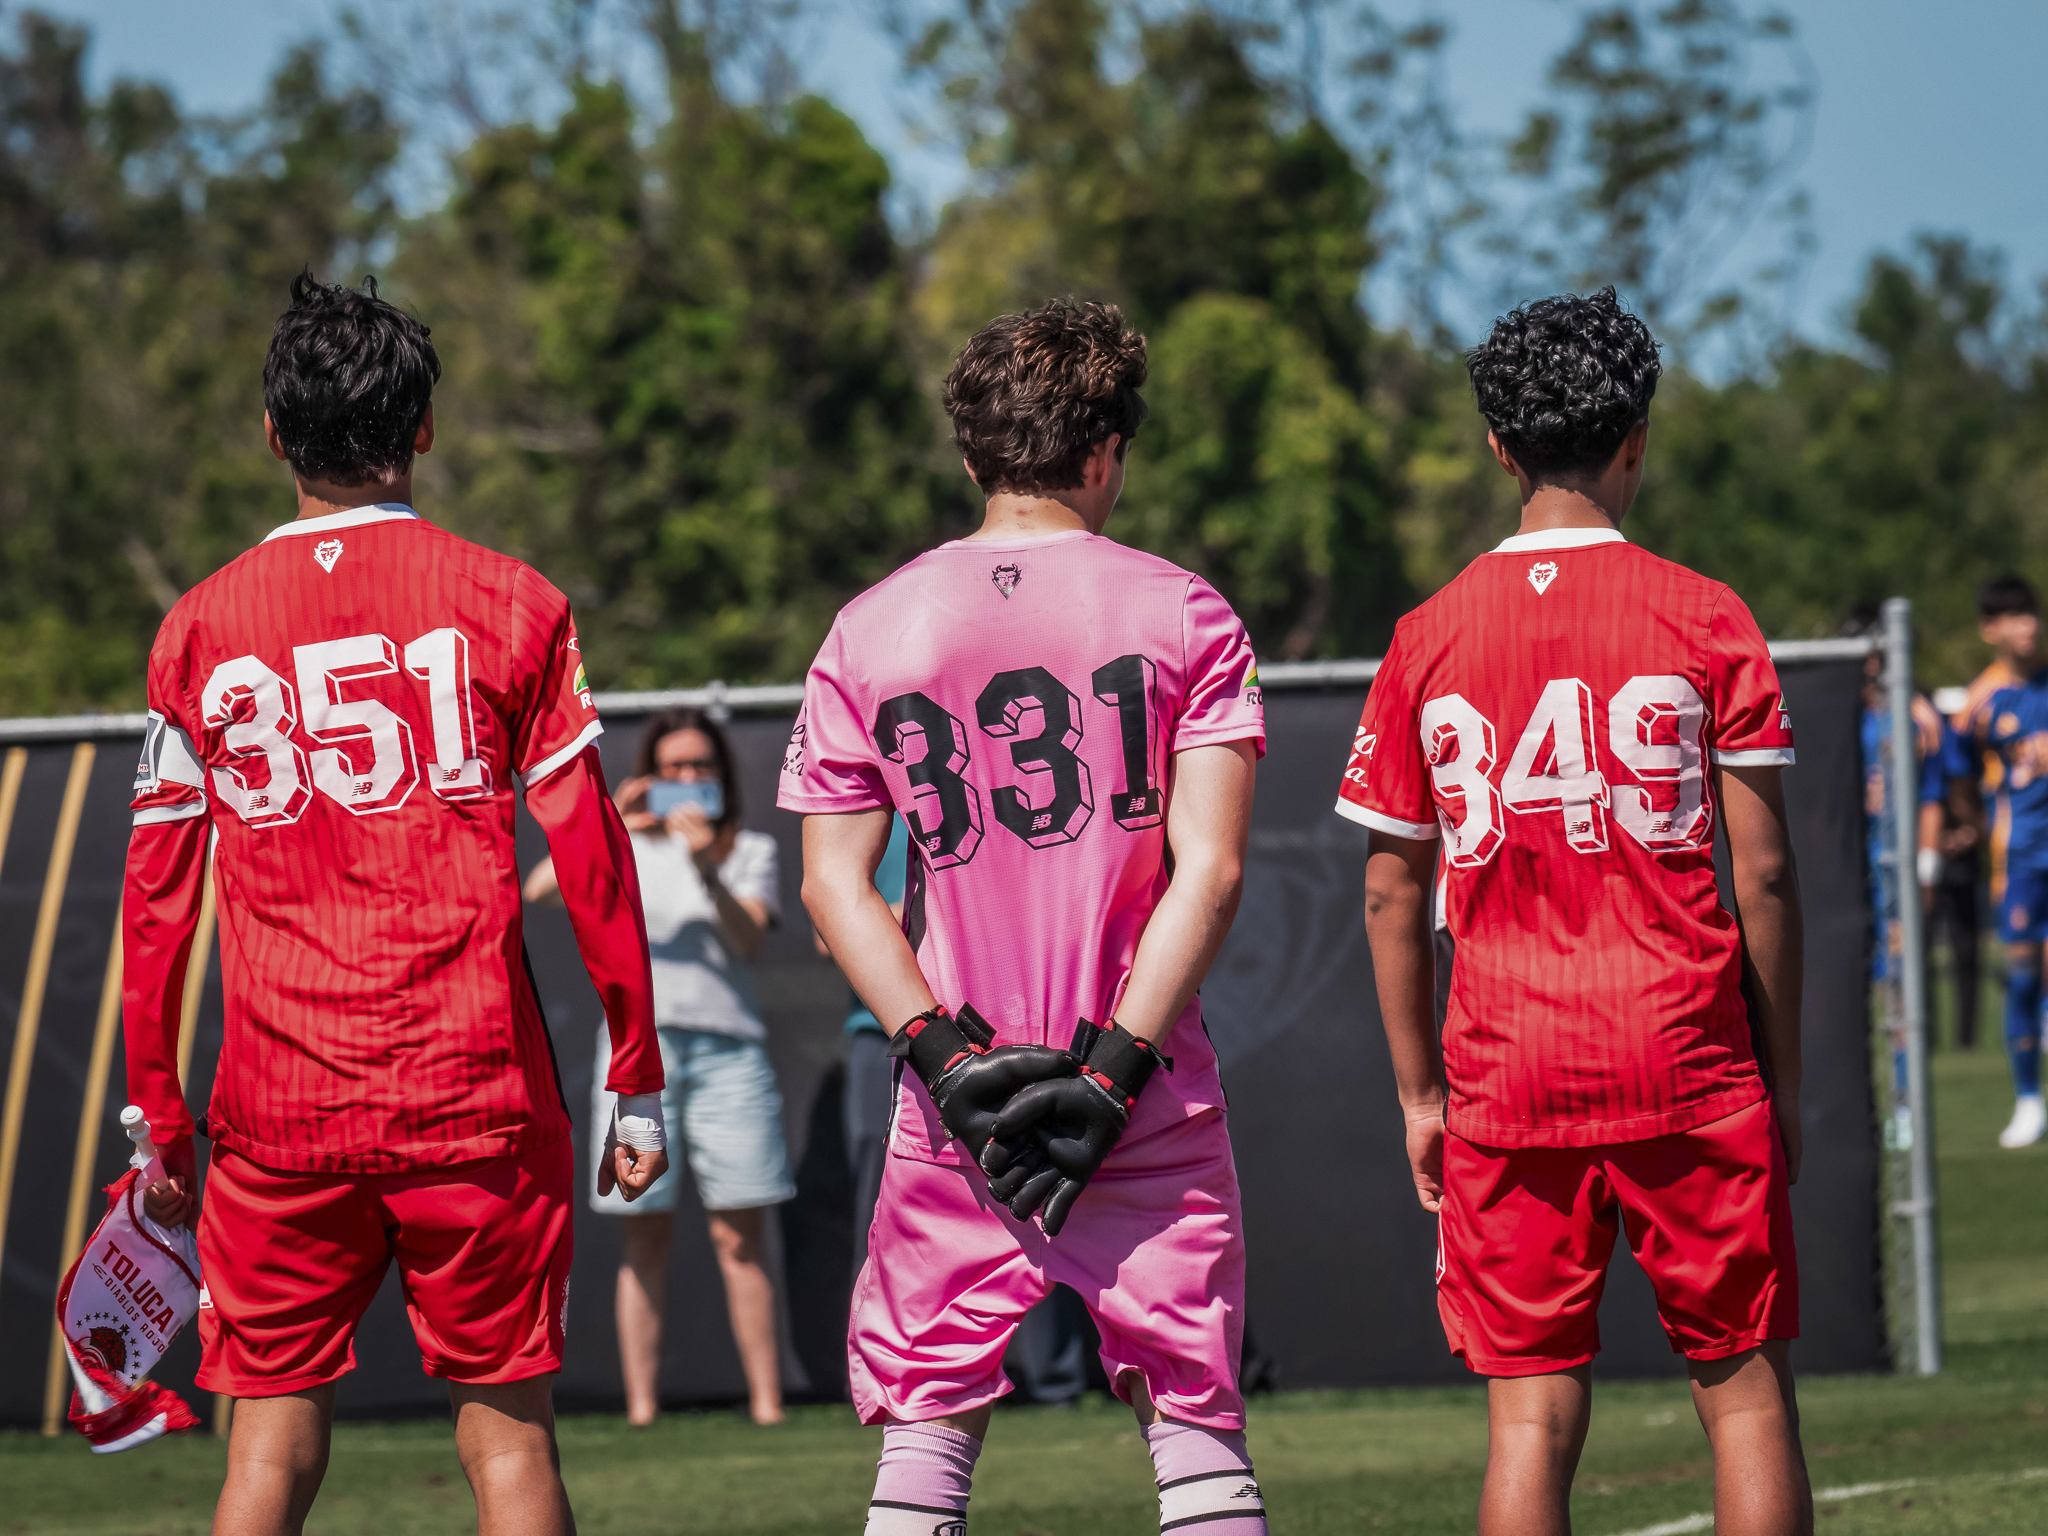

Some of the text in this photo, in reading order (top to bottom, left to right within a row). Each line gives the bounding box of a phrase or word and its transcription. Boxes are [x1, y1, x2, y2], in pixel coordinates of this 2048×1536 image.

[202, 628, 494, 829] 351
[872, 654, 1164, 871] 331
[1420, 675, 1712, 868] 349
[101, 1240, 175, 1334] TOLUCA
[104, 1277, 140, 1322] DIABLOS
